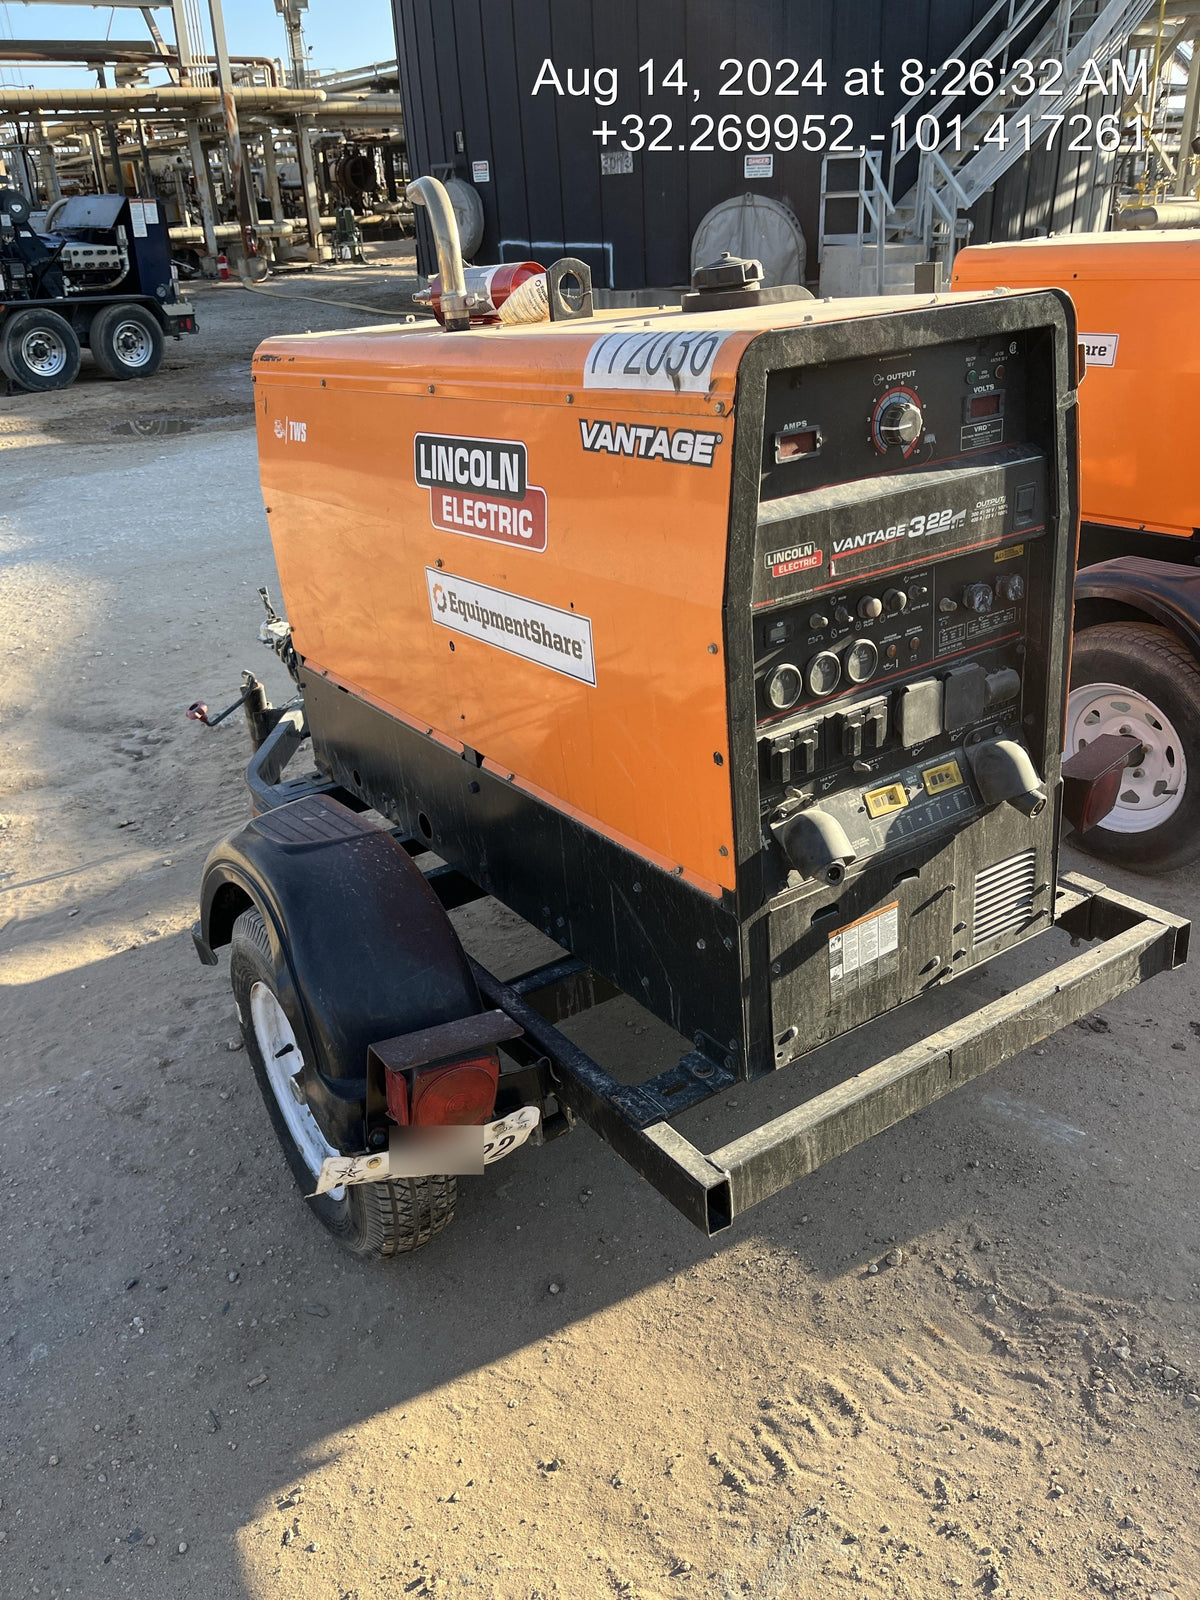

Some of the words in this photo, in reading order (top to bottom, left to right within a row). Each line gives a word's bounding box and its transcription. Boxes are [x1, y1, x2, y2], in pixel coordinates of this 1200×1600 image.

[886, 370, 916, 381] OUTPUT
[973, 384, 994, 393] VOLTS
[289, 421, 307, 442] TWS
[783, 420, 808, 430] AMPS
[579, 419, 717, 467] VANTAGE
[420, 443, 519, 493] LINCOLN
[442, 494, 533, 538] ELECTRIC
[833, 524, 906, 552] VANTAGE
[908, 509, 953, 538] 322
[768, 544, 812, 566] LINCOLN
[778, 556, 818, 574] ELECTRIC
[447, 590, 583, 660] EquipmentShare
